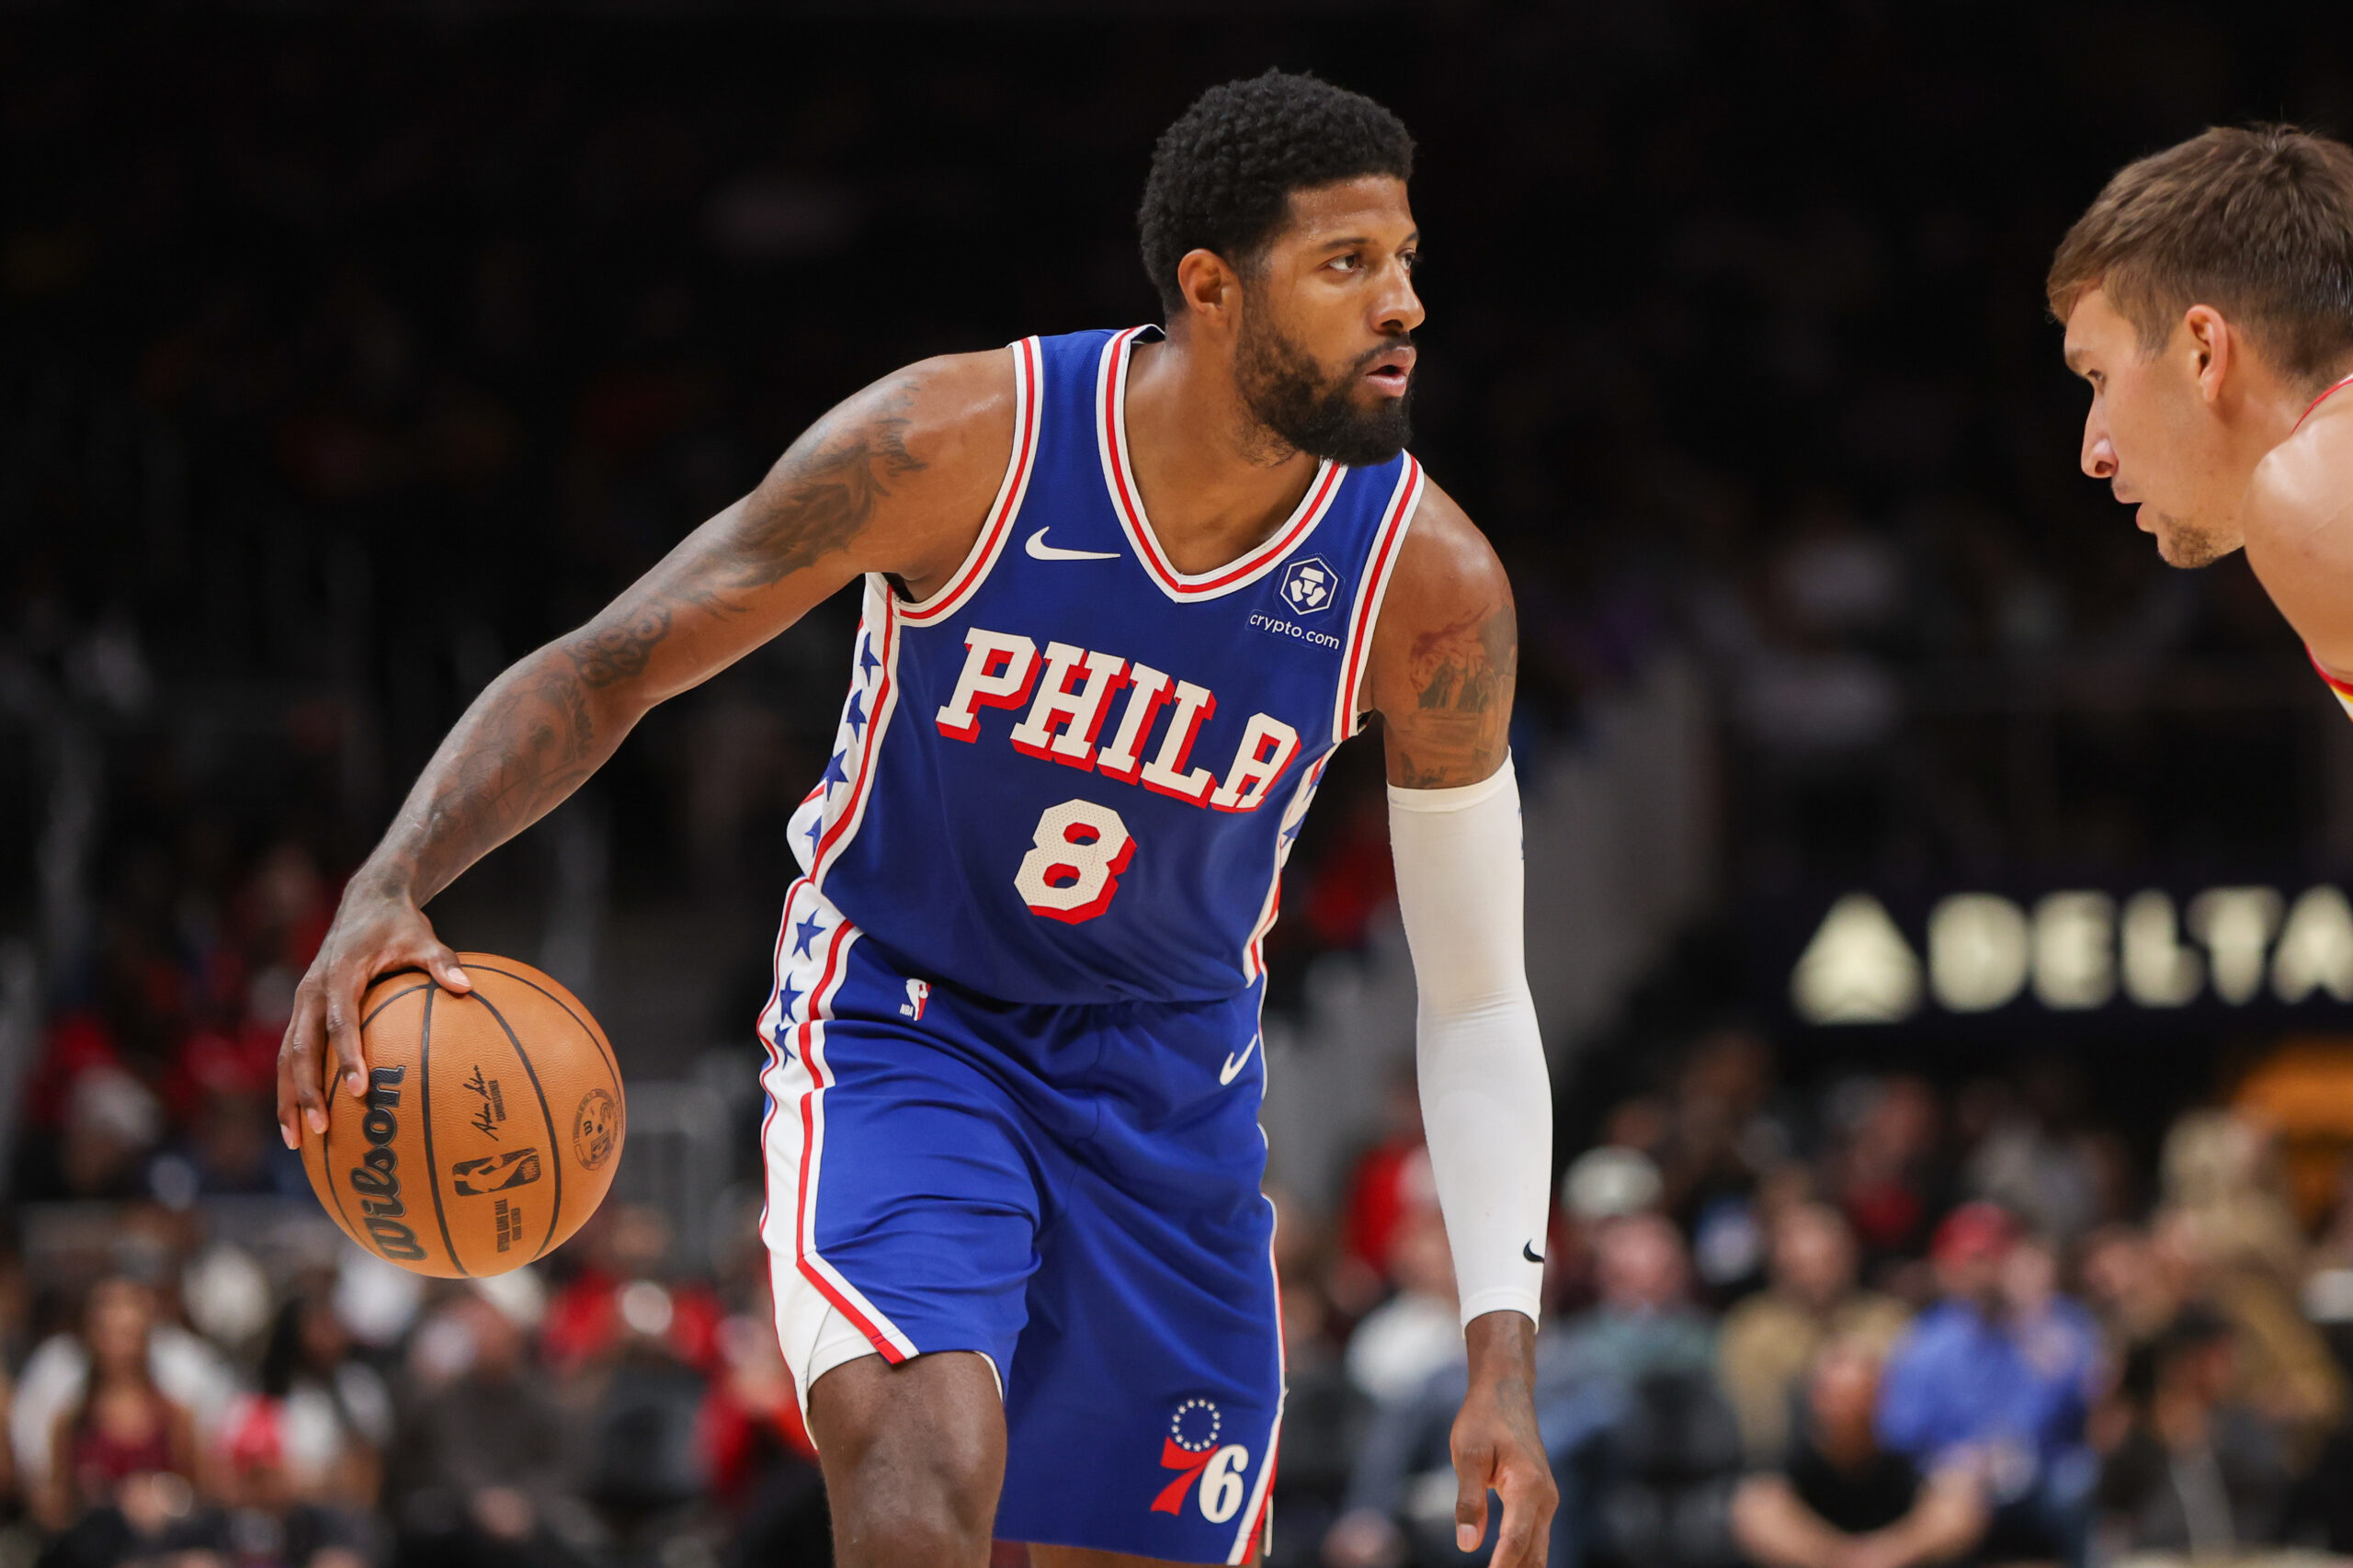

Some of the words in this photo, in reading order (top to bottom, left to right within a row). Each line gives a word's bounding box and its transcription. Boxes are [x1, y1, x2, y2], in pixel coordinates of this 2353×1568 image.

[1250, 614, 1340, 650] crypto.com
[935, 627, 1302, 813] PHILA
[1014, 798, 1138, 926] 8
[1928, 885, 2353, 1013] DELTA
[349, 1064, 428, 1261] Wilson
[1150, 1436, 1249, 1524] 76
